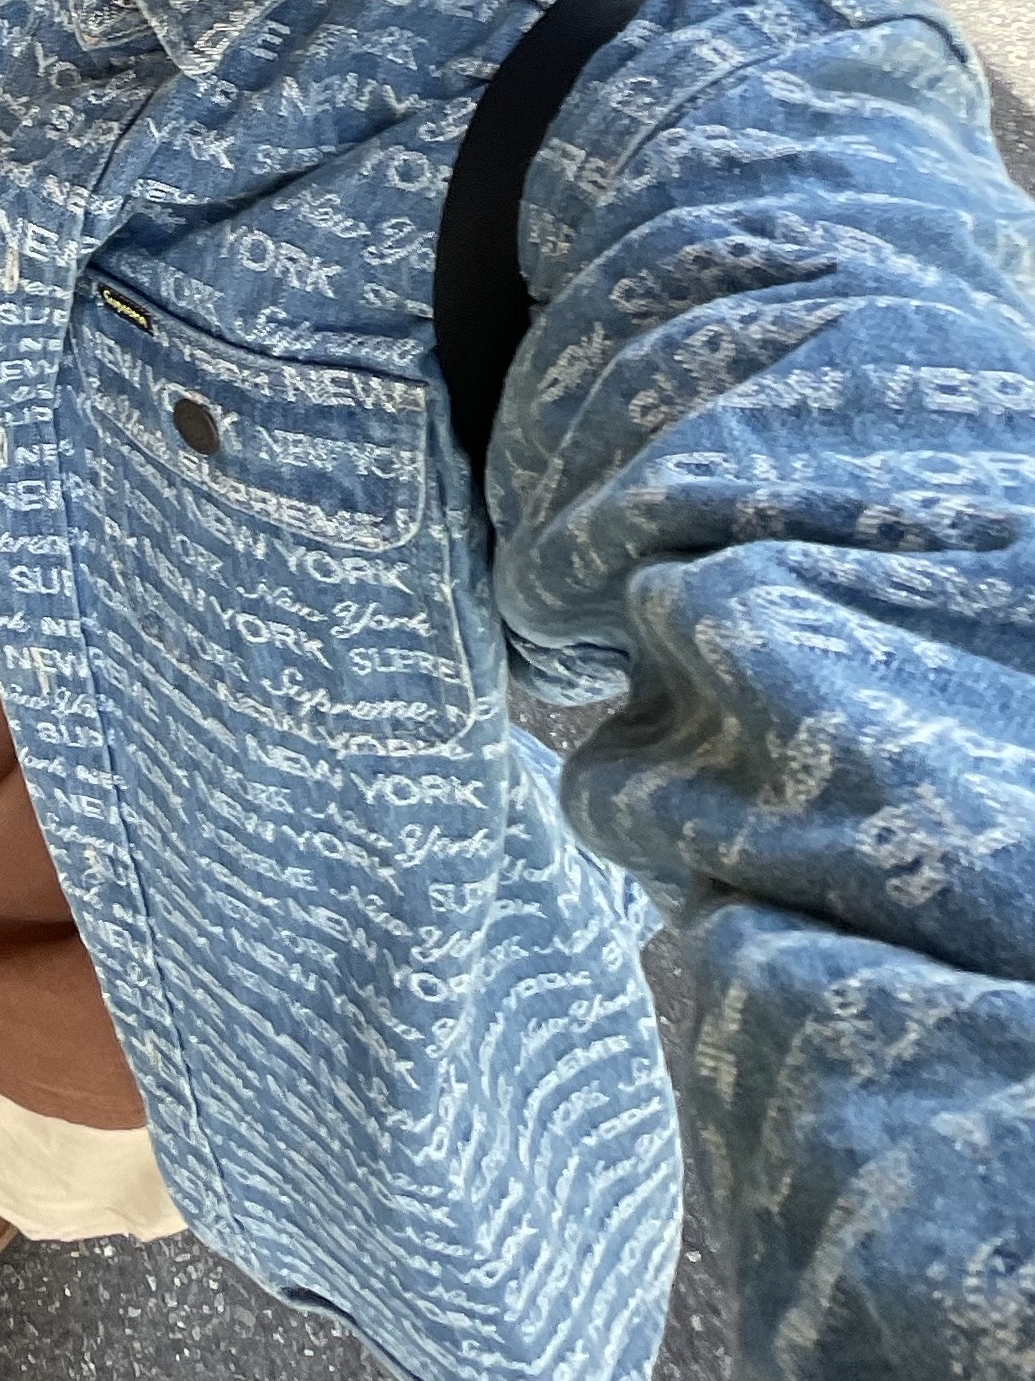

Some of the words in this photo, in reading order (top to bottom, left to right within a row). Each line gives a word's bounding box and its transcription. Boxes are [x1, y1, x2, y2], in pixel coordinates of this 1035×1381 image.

[219, 224, 342, 300] YORK
[272, 534, 415, 596] YORK
[209, 595, 334, 670] YORK
[348, 647, 465, 685] SUPRE
[331, 600, 437, 639] York
[260, 667, 438, 721] Supreme
[350, 772, 488, 809] YORK
[282, 824, 404, 896] YORK
